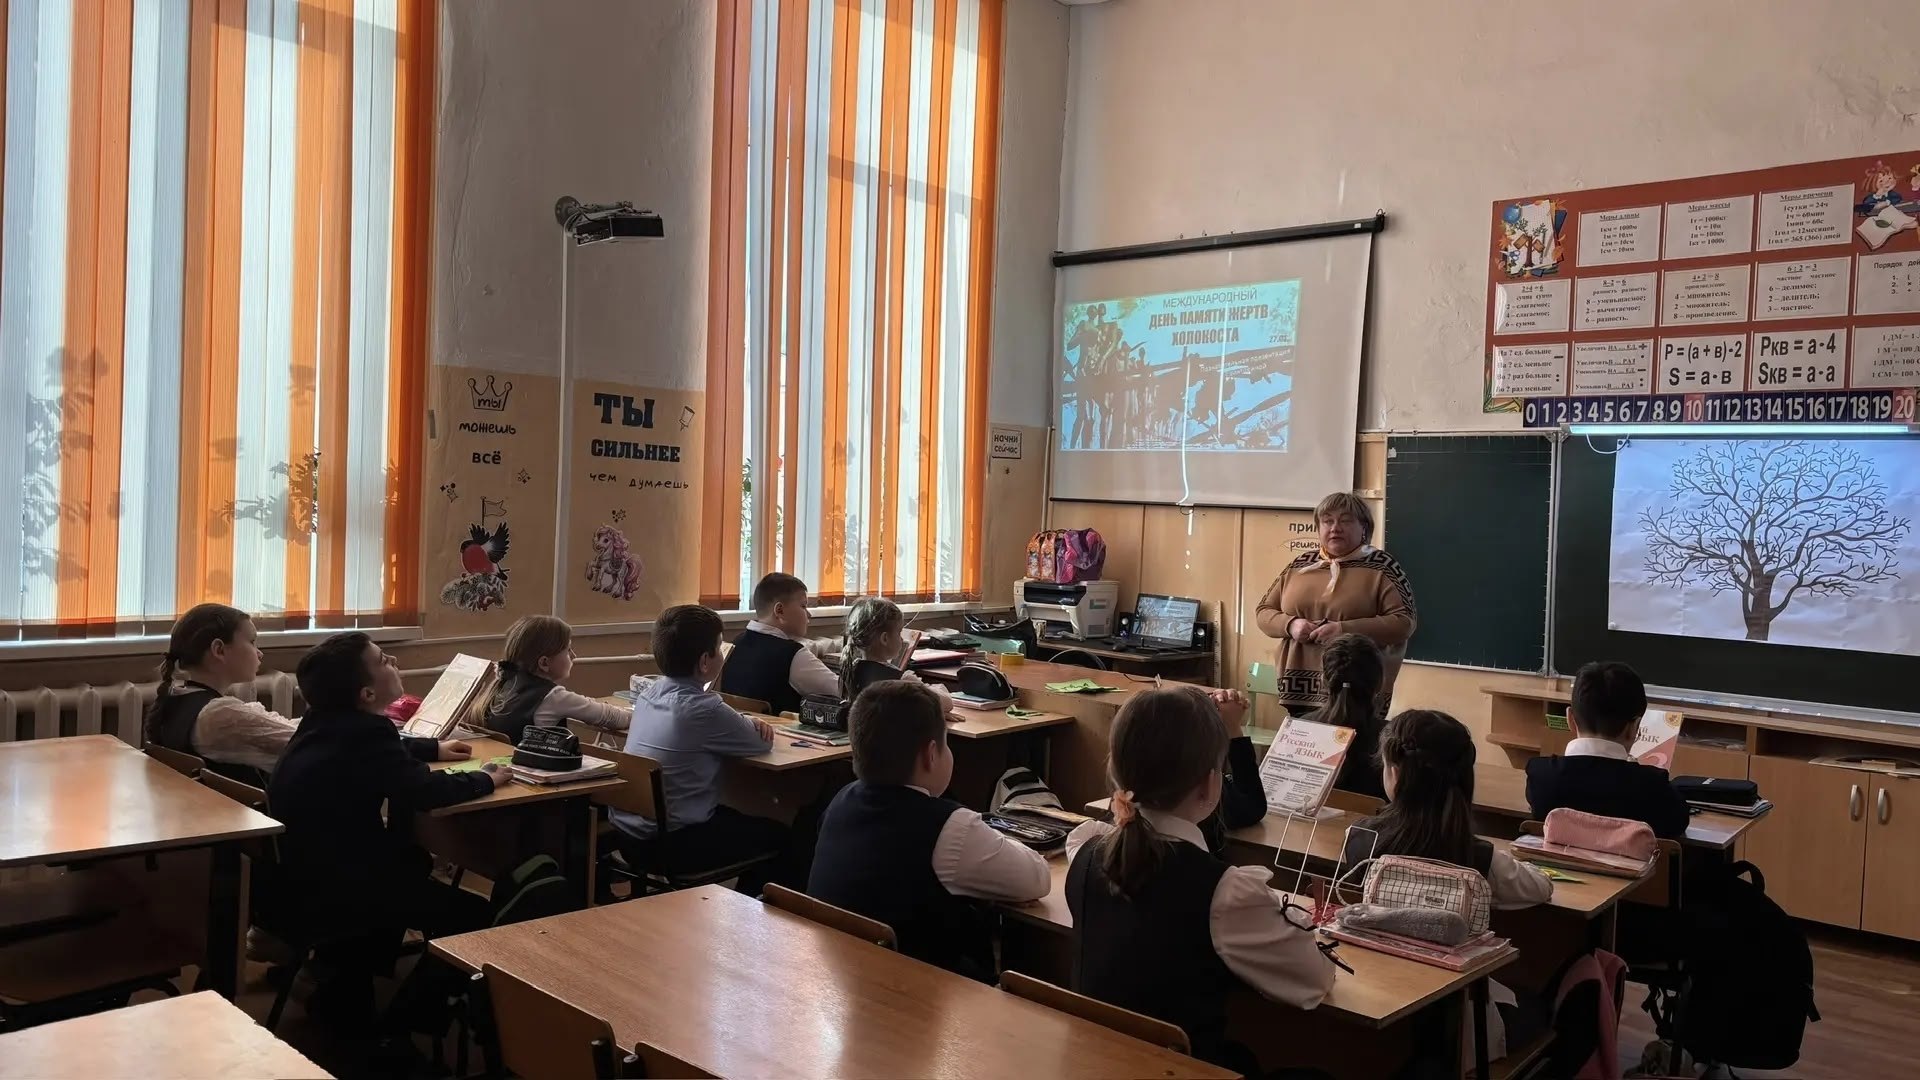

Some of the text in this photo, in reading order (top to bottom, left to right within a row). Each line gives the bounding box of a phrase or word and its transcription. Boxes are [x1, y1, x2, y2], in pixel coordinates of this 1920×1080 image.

[1163, 288, 1257, 308] МЕЖДУНАРОДНЫЙ
[1149, 304, 1269, 330] ДЕНЬ ПАМЯТИ ЖЕРТВ
[1172, 327, 1239, 346] ХОЛОКОСТА
[1677, 348, 1684, 356] =
[1703, 345, 1710, 356] +
[1794, 340, 1803, 350] =
[1669, 368, 1680, 385] S
[1686, 372, 1695, 380] =
[1793, 367, 1802, 377] =
[478, 399, 501, 408] ты
[594, 393, 655, 428] ТЫ
[1526, 395, 1914, 423] 0 1 2 3 4 5 6 7 8 9 10 11 12 13 14 15 16 17 18 19 20
[459, 423, 516, 434] можешь
[472, 451, 501, 464] всё
[591, 439, 680, 462] СИЛЬНЕЕ
[590, 473, 689, 489] чем думаешь
[1279, 734, 1316, 748] Русский
